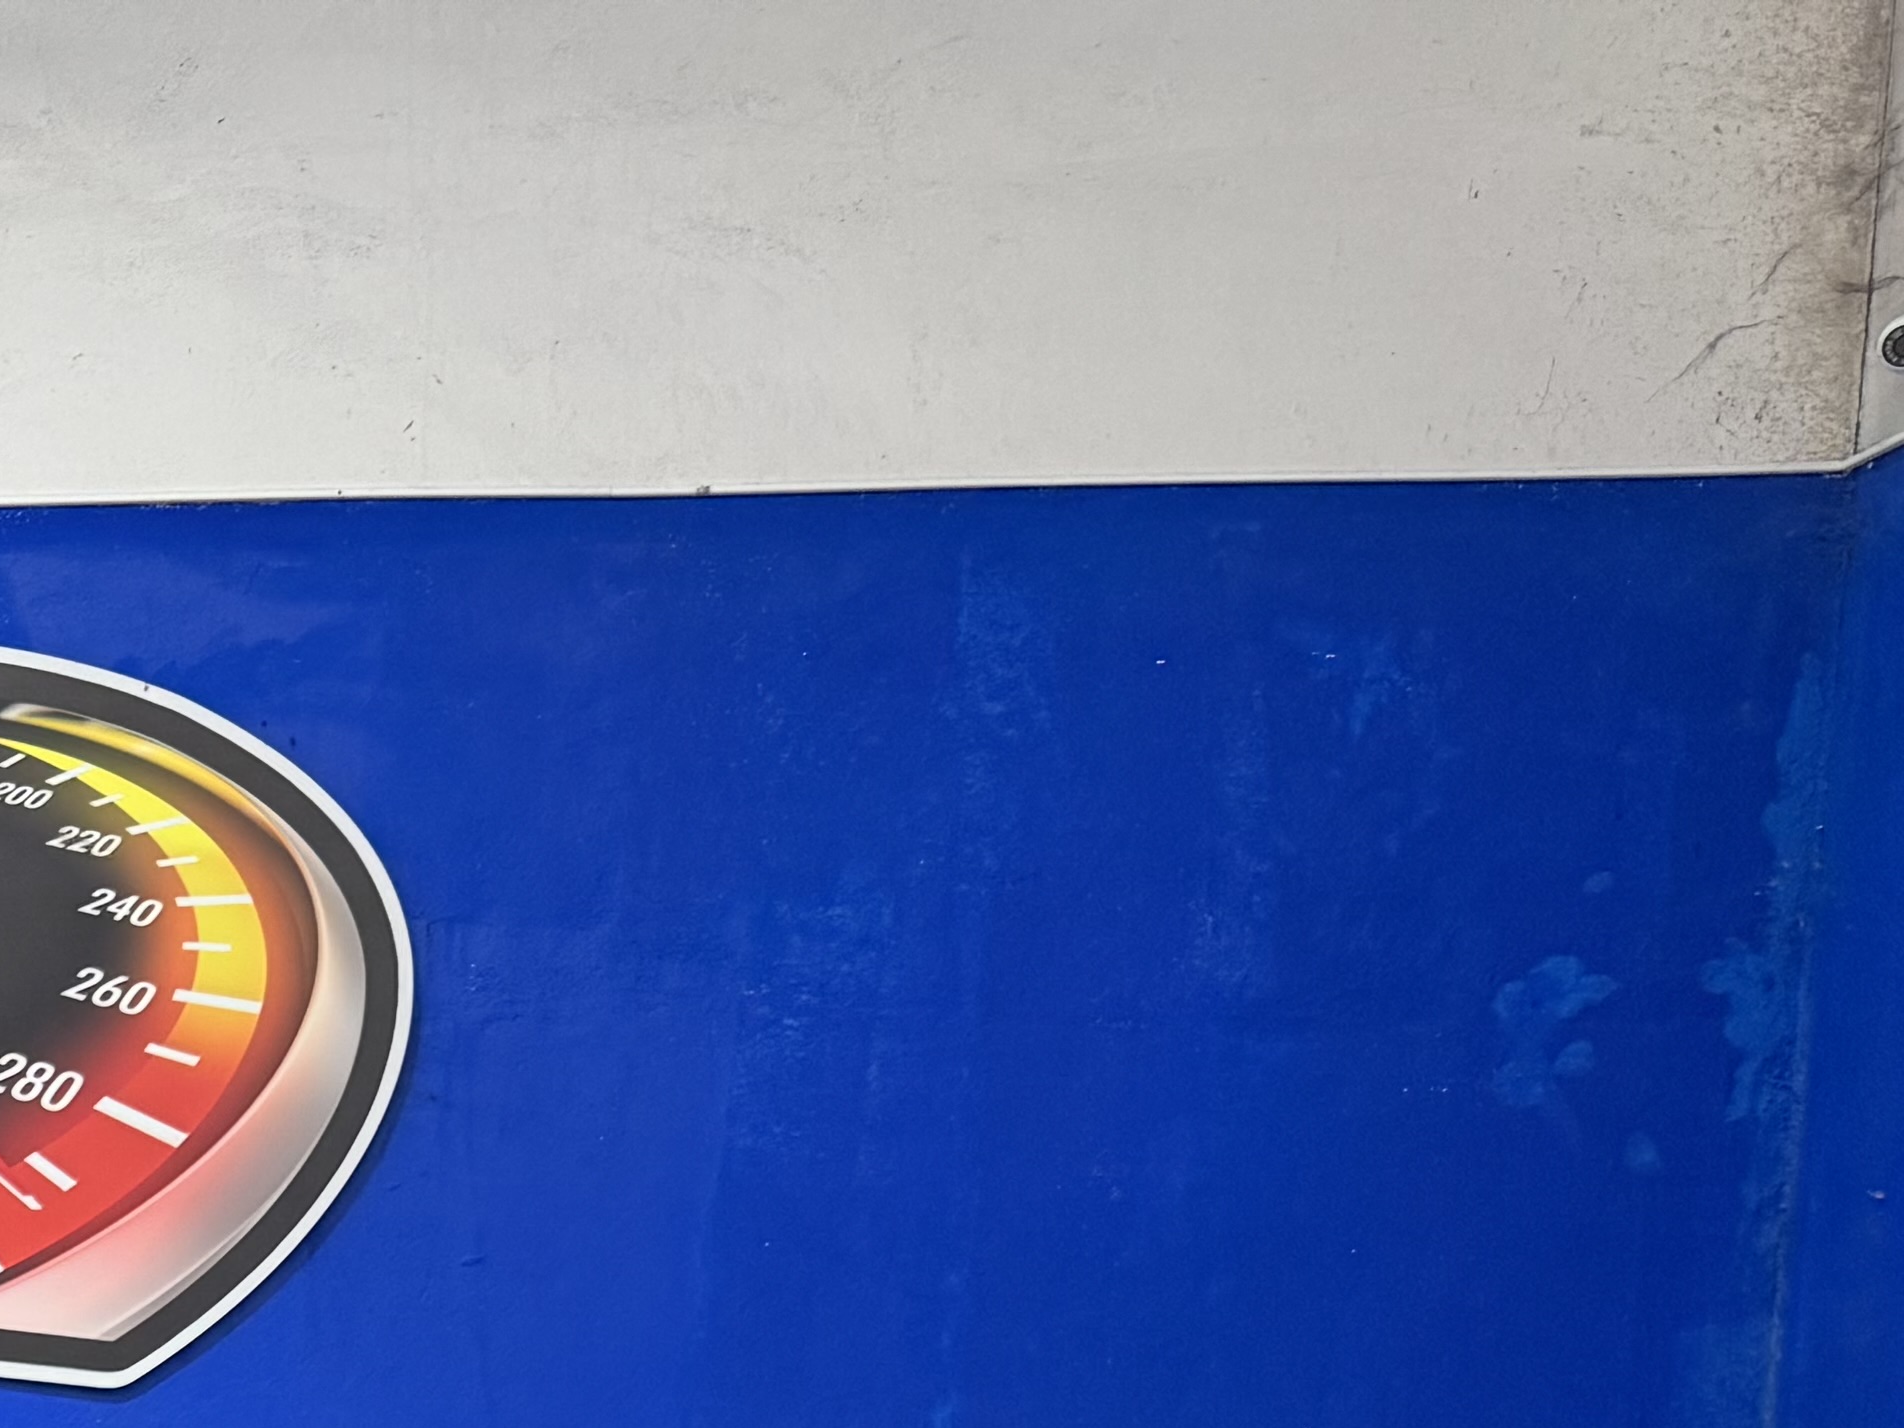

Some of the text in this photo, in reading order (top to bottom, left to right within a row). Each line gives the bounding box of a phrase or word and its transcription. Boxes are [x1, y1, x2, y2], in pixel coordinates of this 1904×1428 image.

[45, 825, 122, 858] 220
[77, 887, 164, 928] 240
[60, 966, 157, 1016] 260
